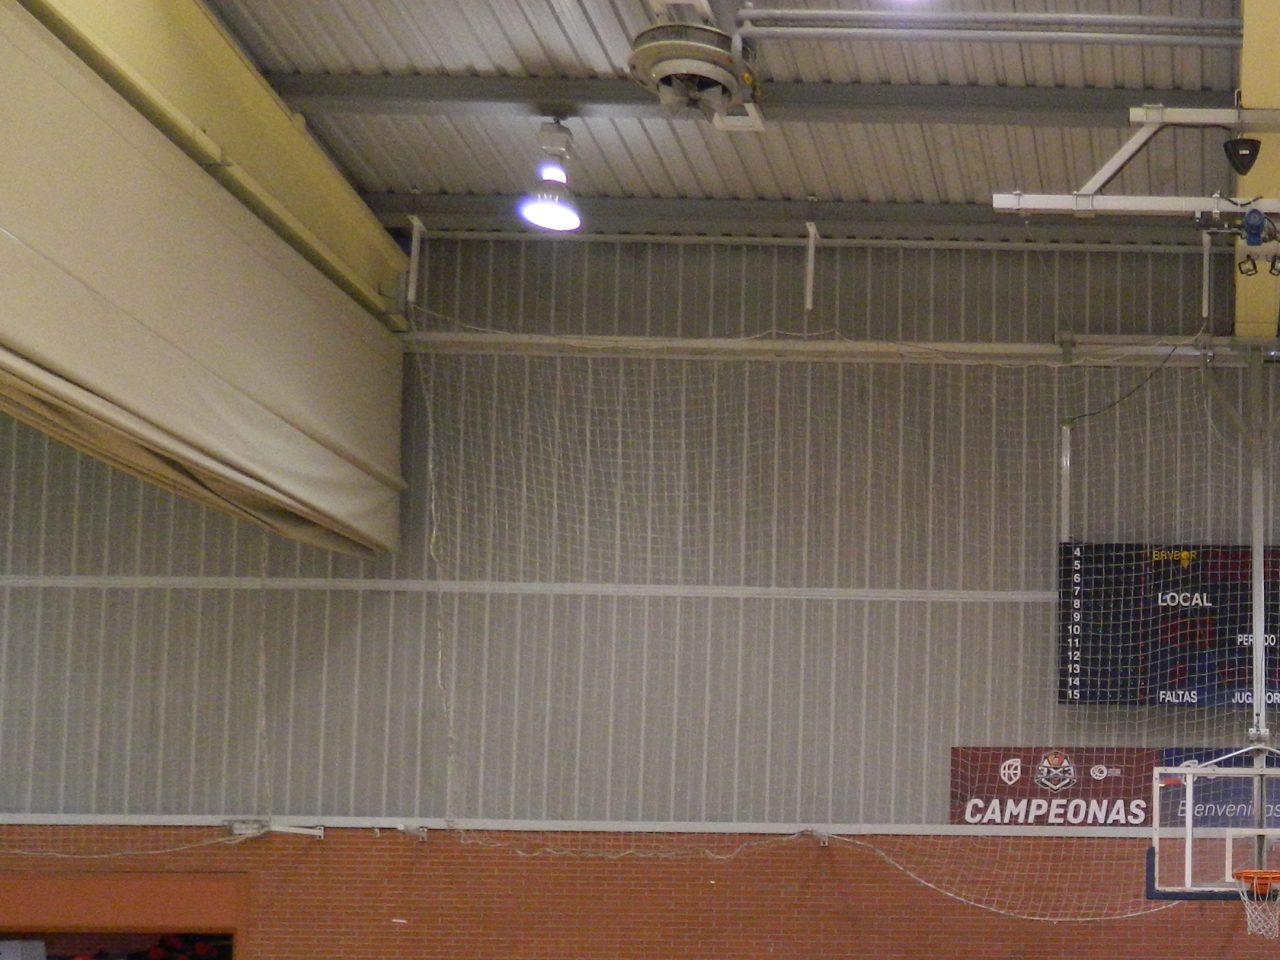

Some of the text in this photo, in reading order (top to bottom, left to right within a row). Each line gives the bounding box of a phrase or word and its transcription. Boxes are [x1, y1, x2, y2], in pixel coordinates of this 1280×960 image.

[1074, 548, 1080, 556] 4
[1074, 560, 1080, 570] 5
[1074, 574, 1080, 582] 6
[1074, 586, 1080, 596] 7
[1158, 592, 1212, 606] LOCAL
[1074, 600, 1080, 608] 8
[1074, 612, 1080, 621] 9
[1068, 624, 1080, 634] 10
[1068, 638, 1080, 647] 11
[1237, 634, 1276, 645] PERDO
[1068, 651, 1080, 660] 12
[1068, 664, 1080, 673] 13
[1068, 677, 1080, 686] 14
[1068, 690, 1080, 699] 15
[1160, 690, 1197, 702] FALTAS
[1232, 692, 1280, 703] JUGOR
[964, 799, 1146, 825] CAMPEONAS
